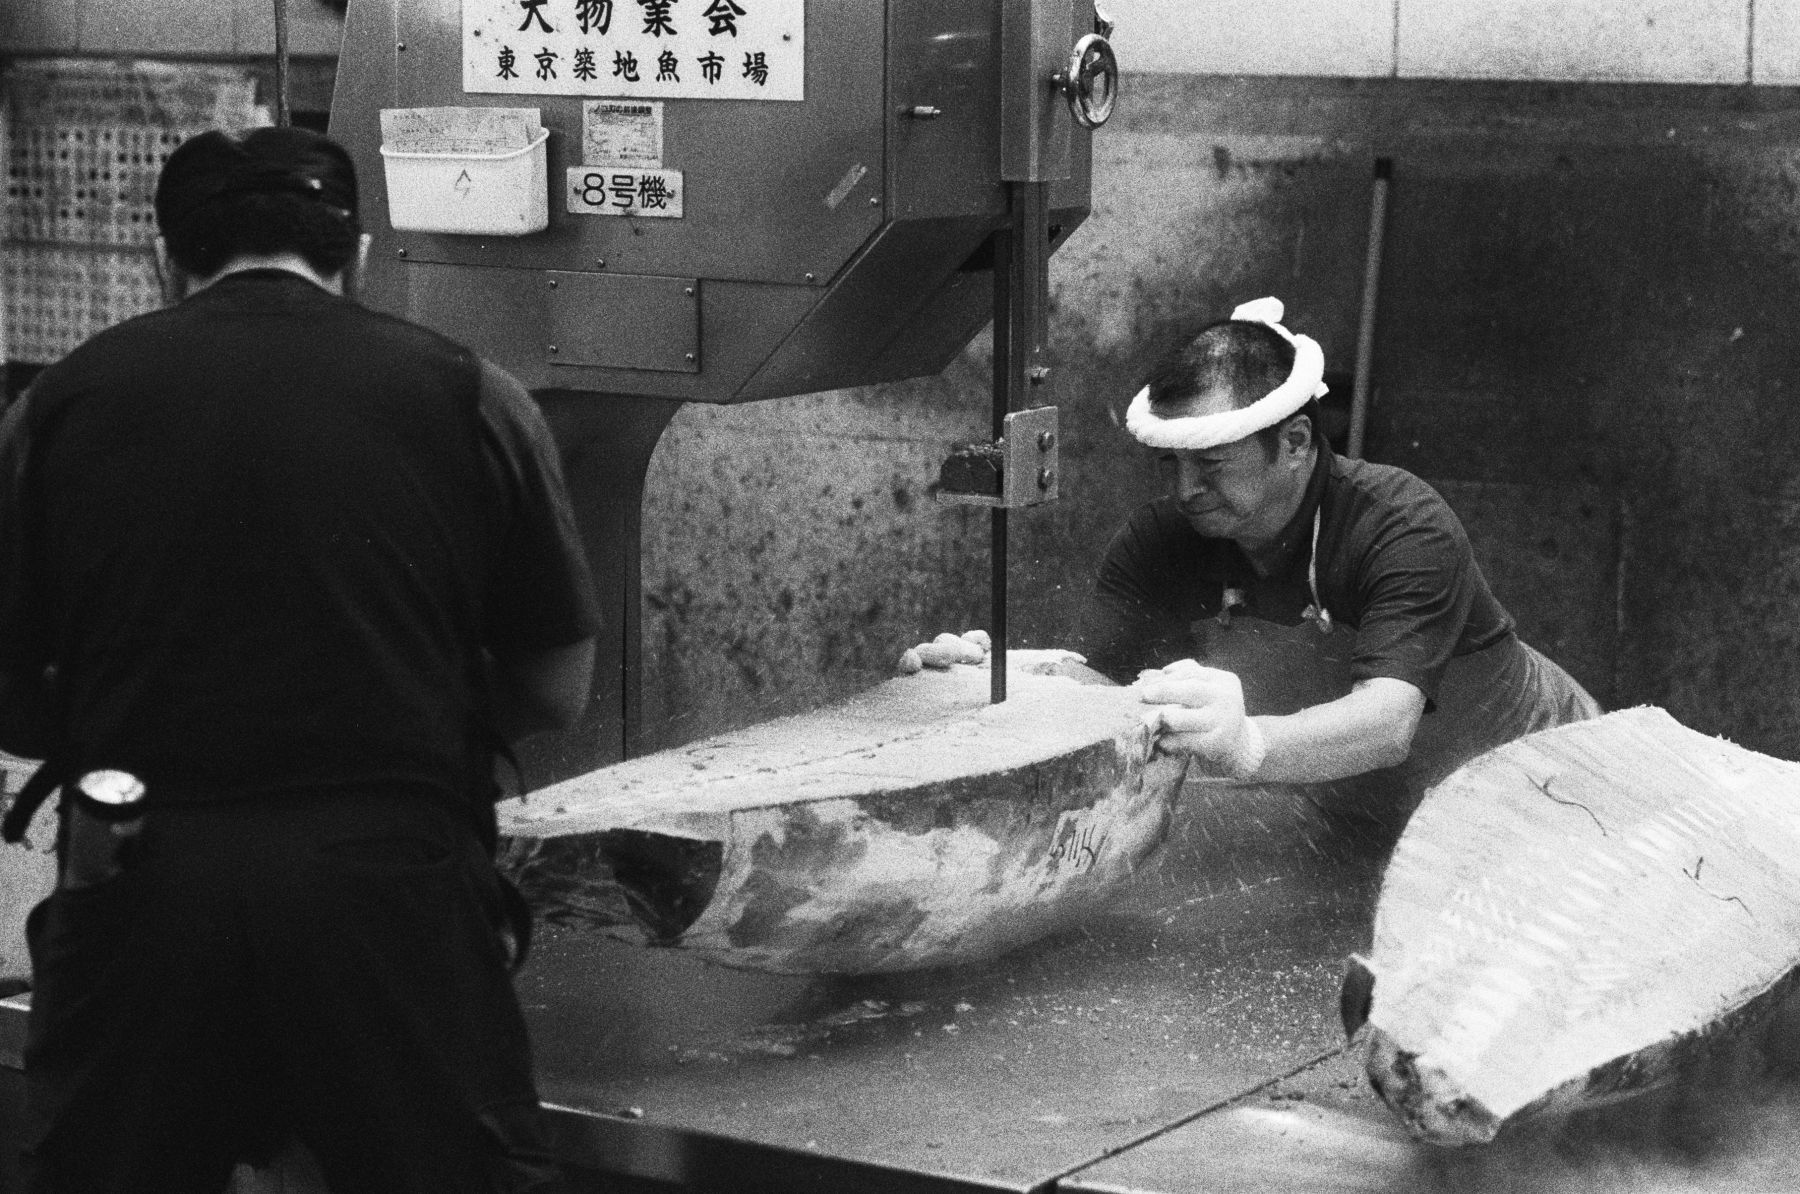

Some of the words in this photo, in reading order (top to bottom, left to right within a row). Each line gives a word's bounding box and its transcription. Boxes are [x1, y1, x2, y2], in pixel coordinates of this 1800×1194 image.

[517, 0, 747, 38] 大物業会
[496, 45, 769, 87] 東京築地魚市場
[582, 172, 667, 209] 8号機
